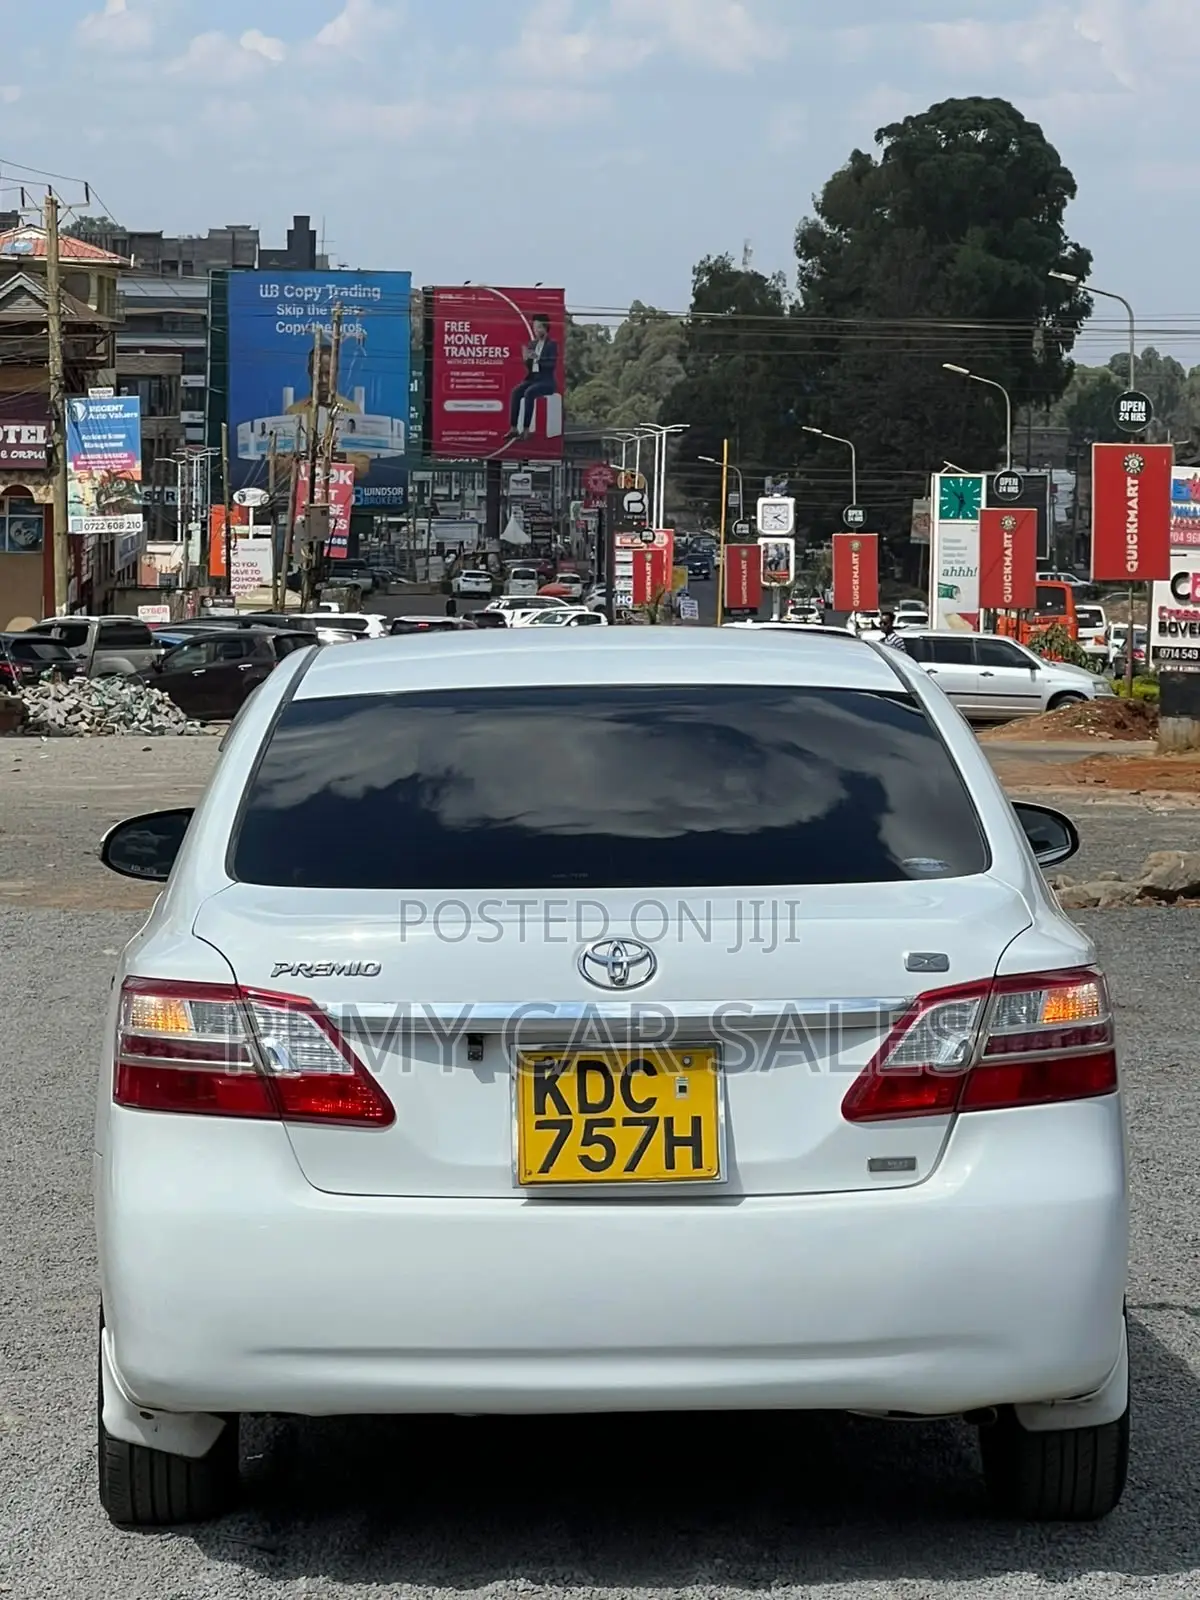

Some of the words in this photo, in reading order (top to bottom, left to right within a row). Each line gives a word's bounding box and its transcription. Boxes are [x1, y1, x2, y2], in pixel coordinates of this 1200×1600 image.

[284, 285, 321, 301] Copy
[326, 284, 381, 301] Trading
[277, 303, 304, 318] Skip
[307, 304, 328, 316] the
[276, 321, 305, 336] Copy
[444, 321, 471, 332] FREE
[444, 334, 488, 345] MONEY
[443, 346, 510, 358] TRANSFERS
[89, 404, 124, 412] REGENT
[1120, 401, 1146, 412] OPEN
[1118, 412, 1130, 422] 24
[1130, 412, 1147, 422] HRS
[999, 477, 1019, 486] OPEN
[364, 487, 404, 496] WINDSOR
[998, 486, 1007, 494] 24
[364, 496, 403, 505] BROKERS
[84, 522, 105, 531] 0722
[107, 522, 125, 530] 608
[127, 520, 141, 529] 210
[1126, 476, 1139, 573] QUICKMART
[942, 565, 979, 577] ahhh!
[1003, 532, 1013, 604] QUICKMART
[1157, 622, 1200, 637] BOVE
[1158, 647, 1180, 659] 0714
[1181, 648, 1199, 660] 549
[270, 961, 382, 979] PREMIO
[533, 1058, 658, 1115] KDC
[534, 1116, 703, 1174] 757H
